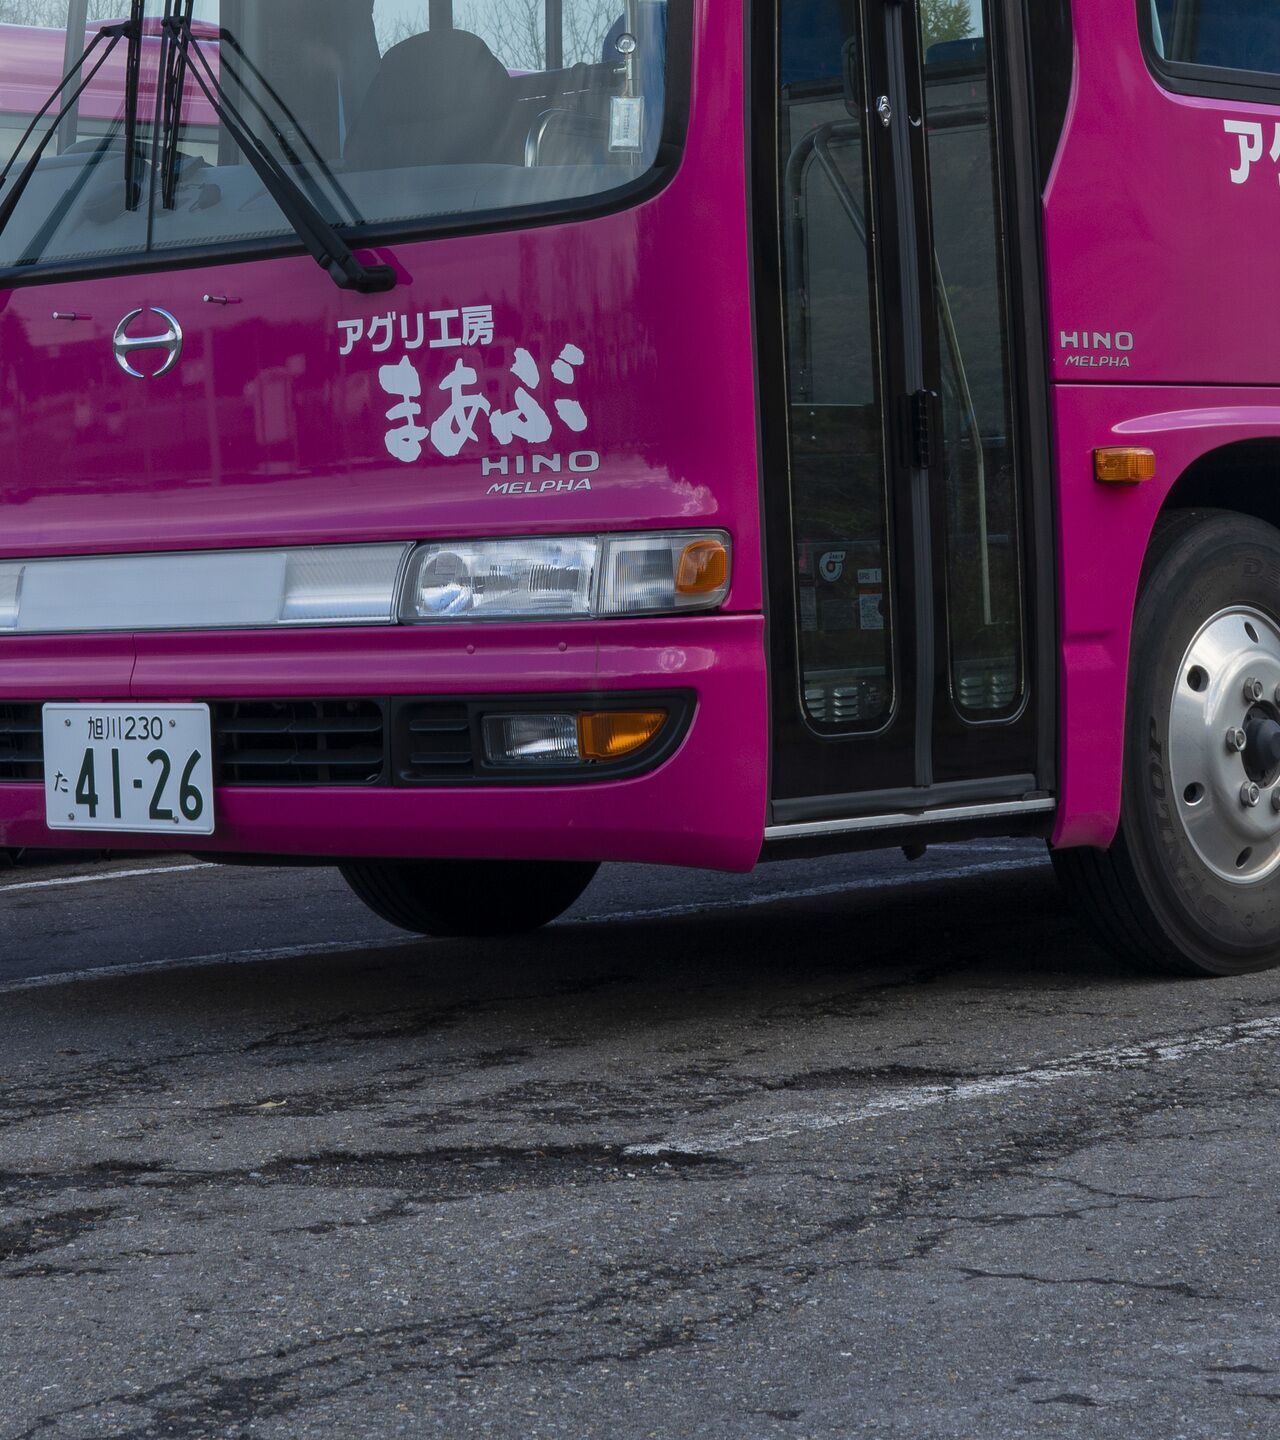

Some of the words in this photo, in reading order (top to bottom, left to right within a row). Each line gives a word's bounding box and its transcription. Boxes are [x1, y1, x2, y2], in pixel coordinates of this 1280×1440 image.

[337, 305, 495, 355] アグリ工房
[1060, 331, 1134, 351] HINO
[1065, 355, 1130, 367] MELPHA
[378, 343, 588, 463] まあぶ
[481, 450, 600, 476] HINO
[486, 478, 592, 495] MELPHA
[55, 771, 68, 793] た
[75, 748, 203, 821] 41-26
